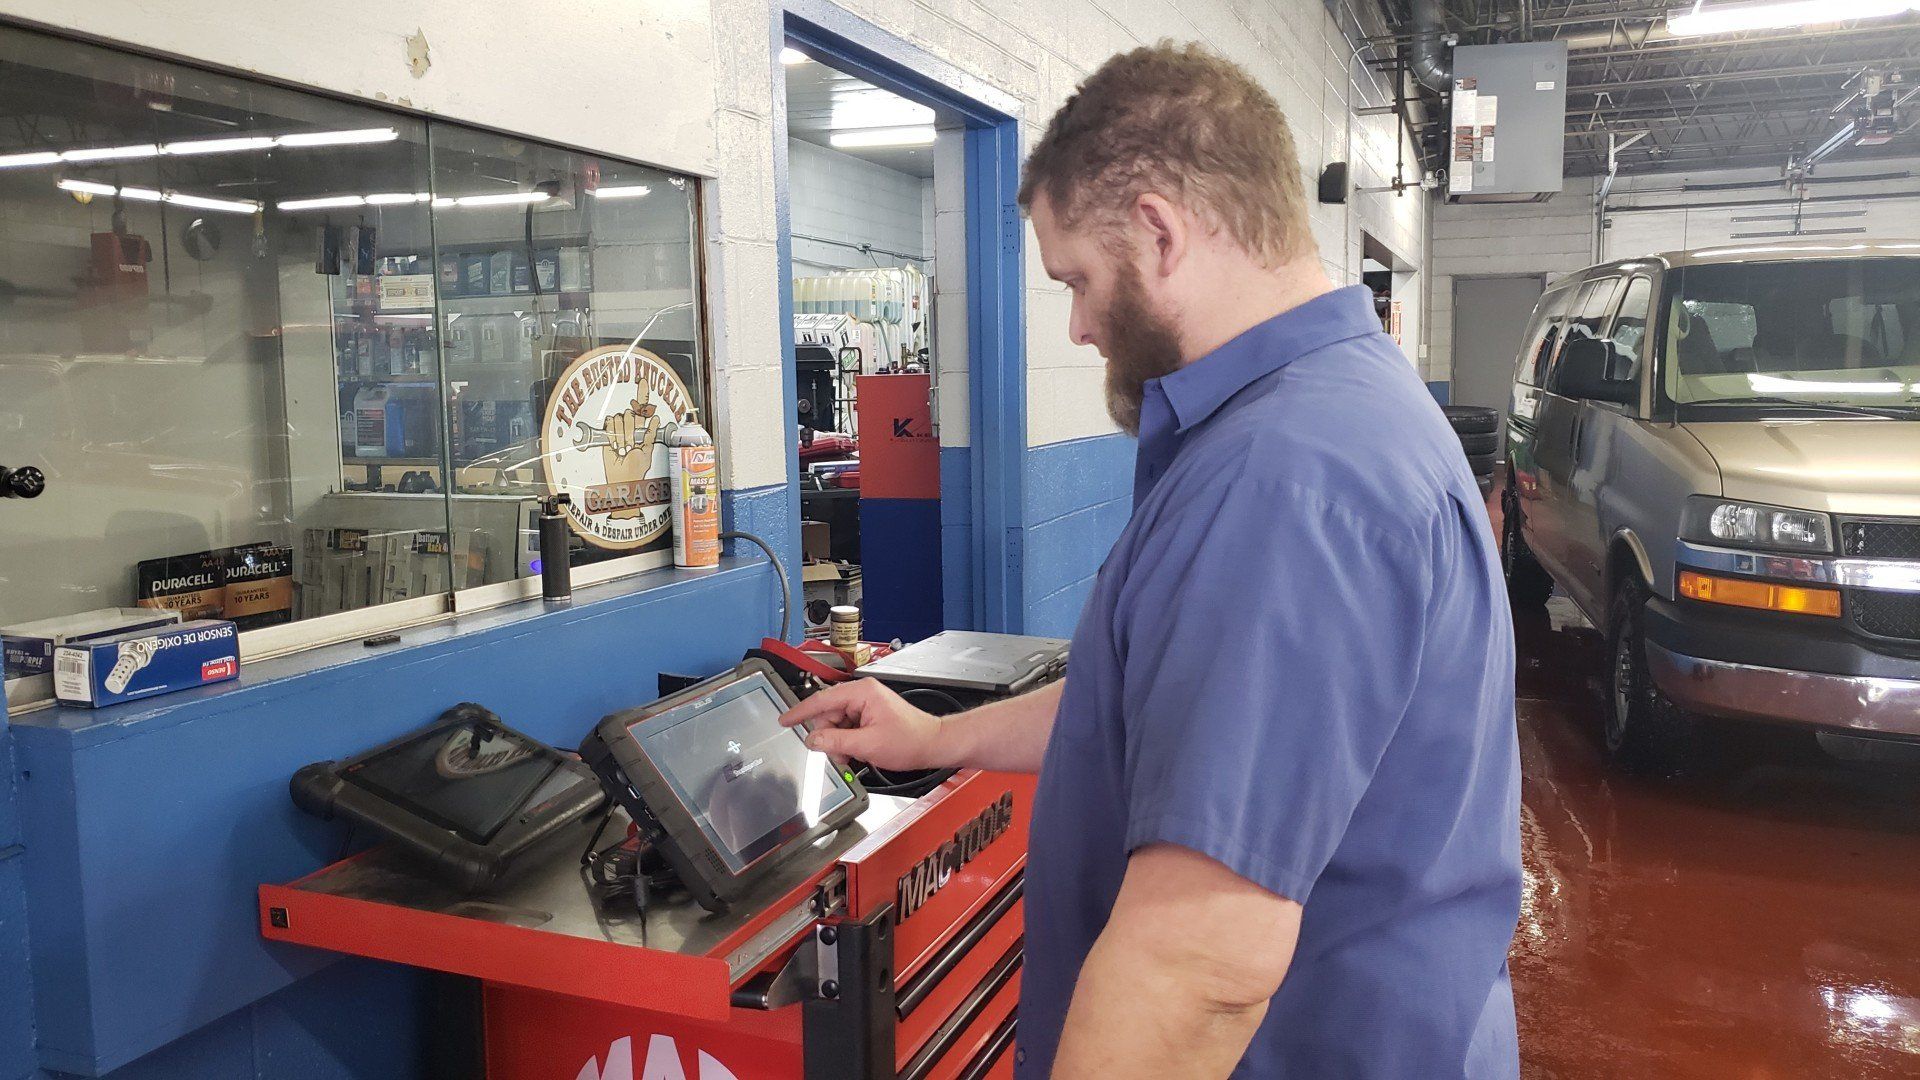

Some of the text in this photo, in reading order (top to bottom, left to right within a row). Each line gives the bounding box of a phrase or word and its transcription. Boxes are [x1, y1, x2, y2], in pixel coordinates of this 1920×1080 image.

[556, 377, 586, 428] THE
[634, 357, 687, 424] KNUCKLE
[586, 481, 671, 513] GARAGE
[594, 523, 600, 534] &
[602, 526, 633, 540] DESPAIR
[635, 519, 658, 537] UNDER
[658, 506, 672, 525] ONE
[152, 573, 214, 592] DURACELL
[175, 597, 202, 607] YEARS
[234, 592, 270, 604] 10 YEARS
[183, 633, 196, 645] DE
[197, 626, 233, 642] SENSOR
[207, 666, 226, 676] DENSO
[896, 790, 1013, 925] MAC TOOLS
